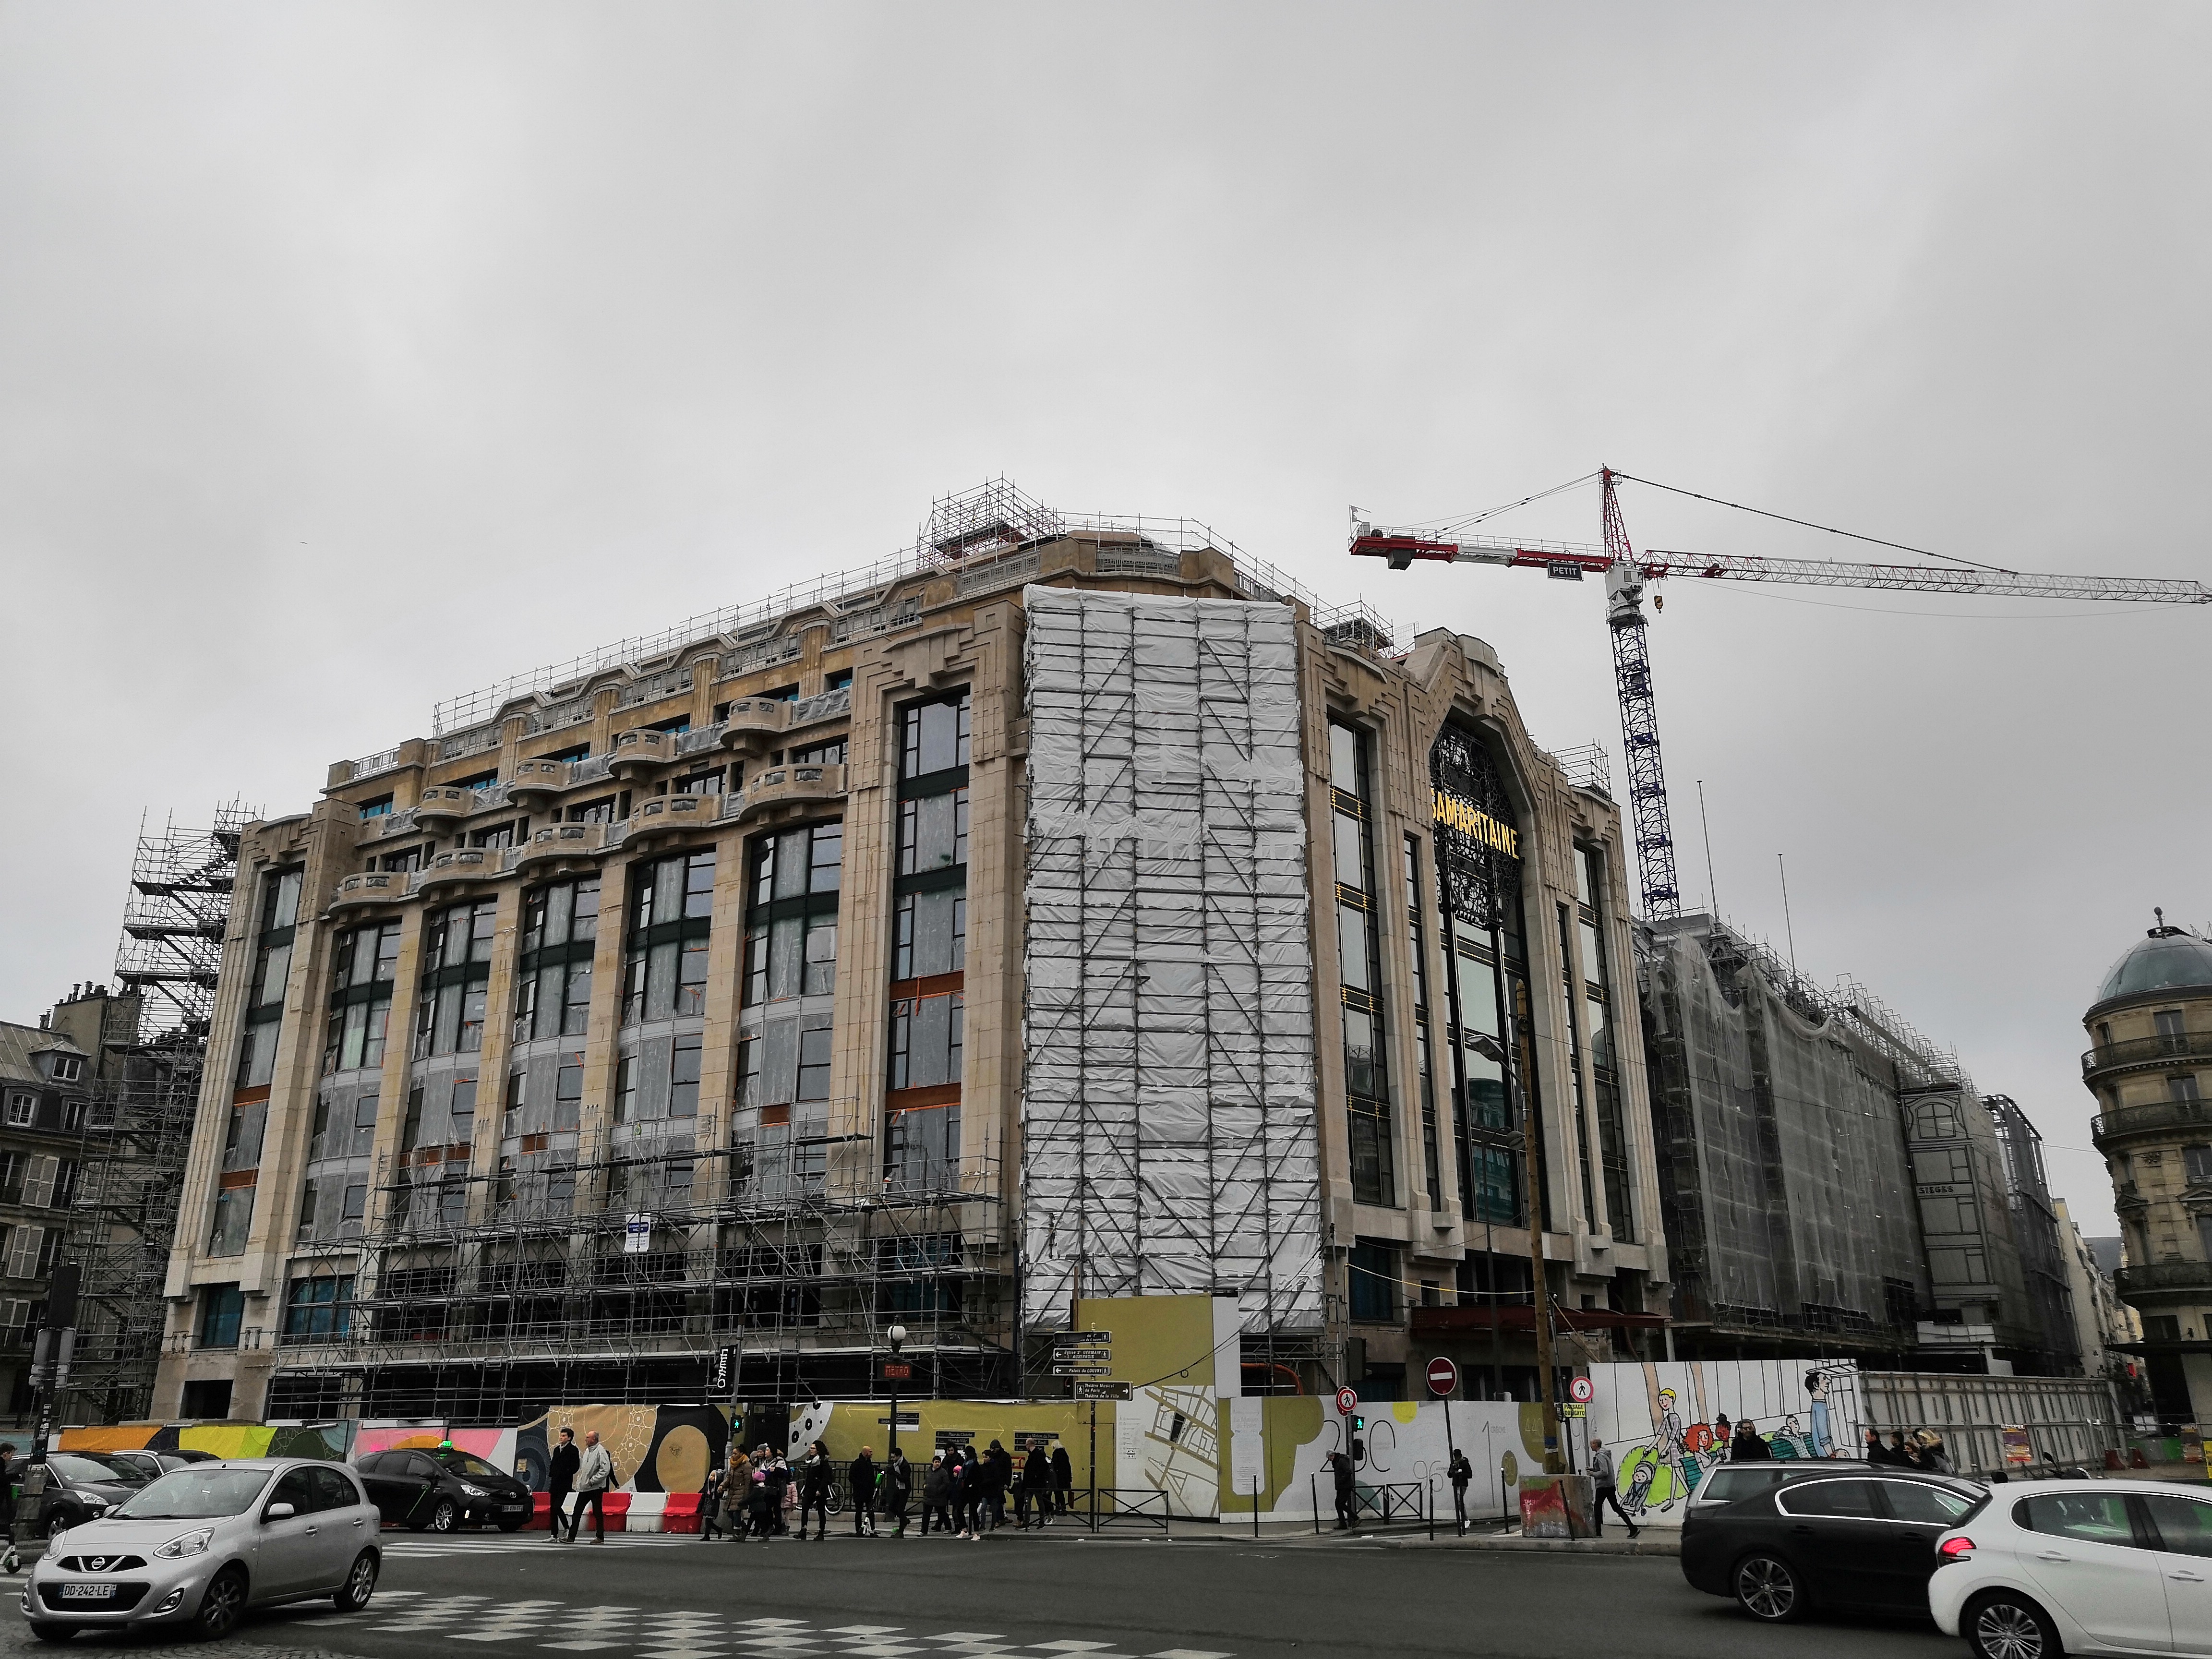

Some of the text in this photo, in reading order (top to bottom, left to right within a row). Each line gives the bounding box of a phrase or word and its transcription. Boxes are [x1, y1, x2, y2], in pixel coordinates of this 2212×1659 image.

[1553, 566, 1577, 575] PETIT
[1413, 1460, 1444, 1492] 96
[64, 1586, 110, 1596] DD-242-LE
